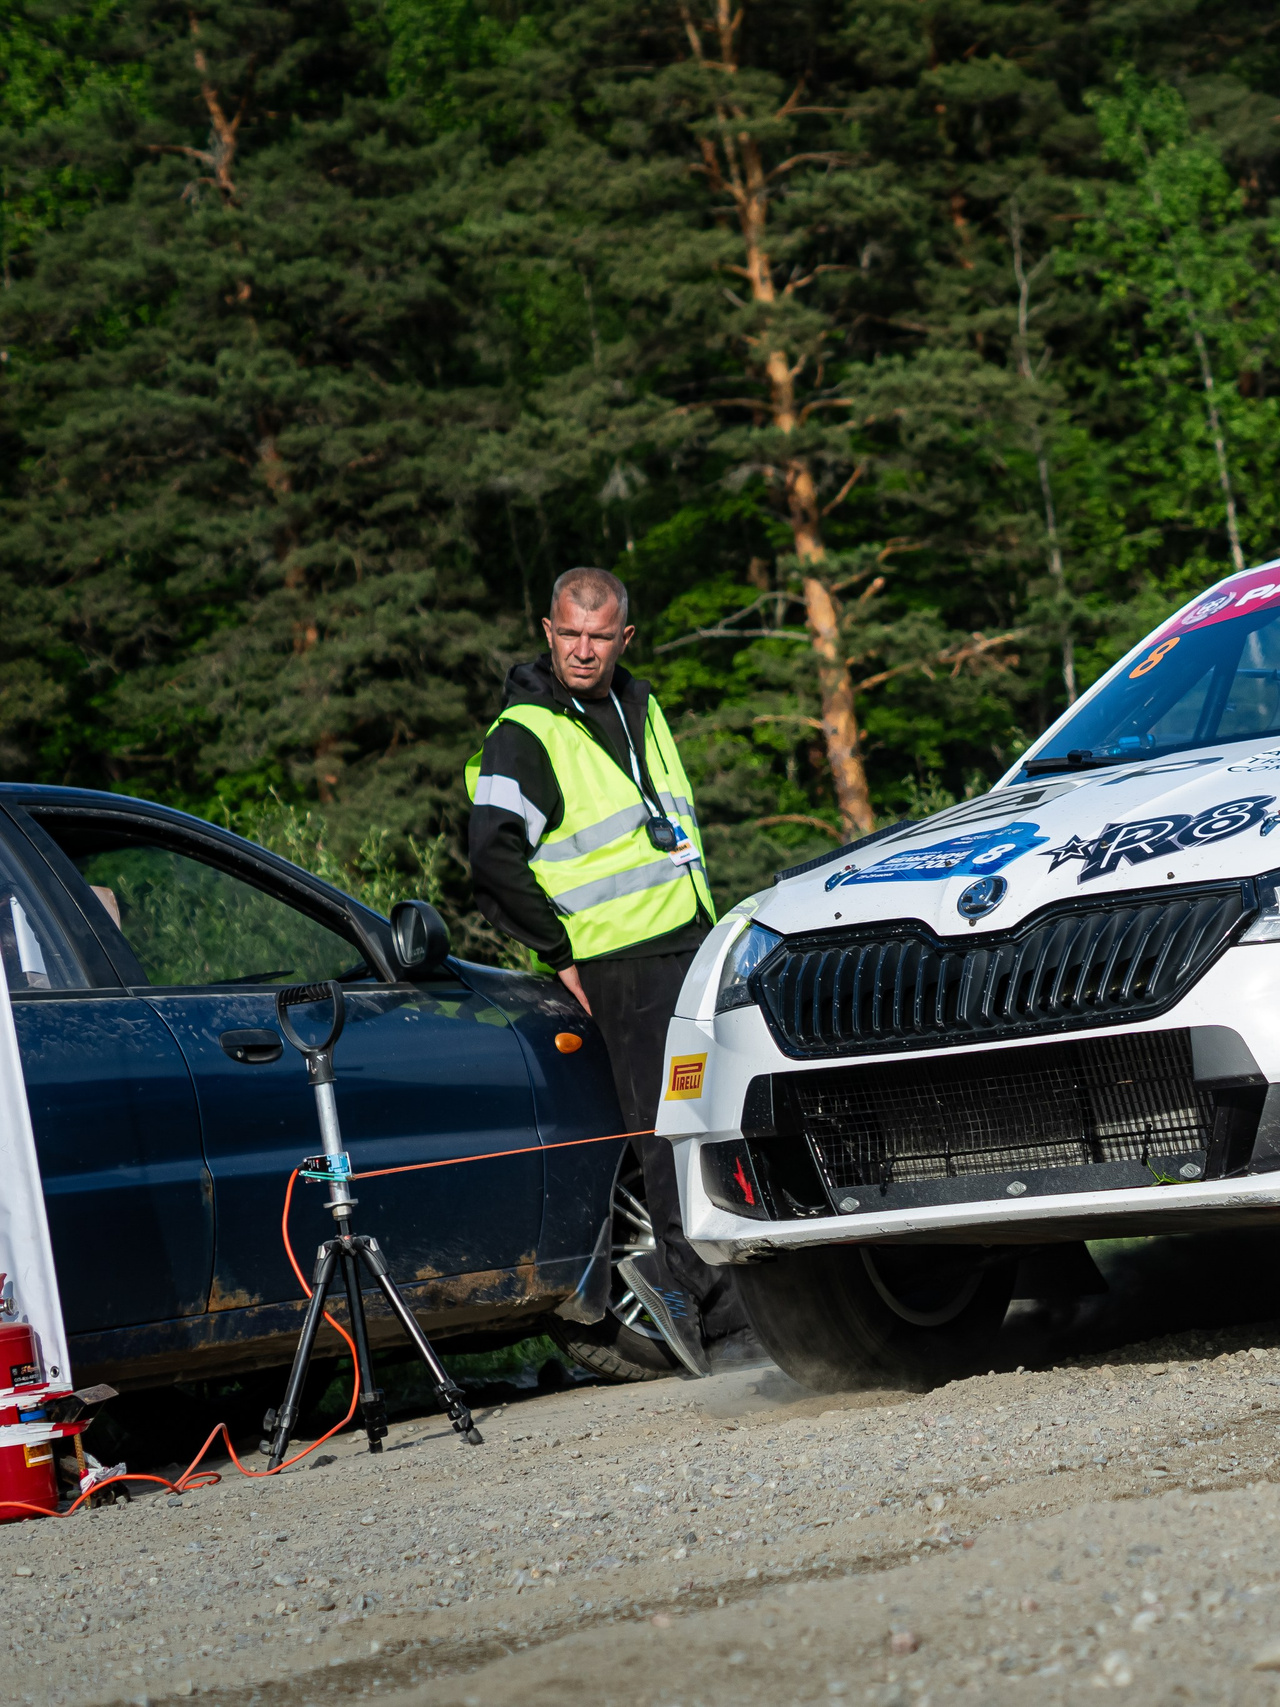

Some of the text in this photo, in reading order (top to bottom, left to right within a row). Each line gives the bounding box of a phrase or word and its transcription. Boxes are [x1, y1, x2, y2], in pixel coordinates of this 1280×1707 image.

[1129, 637, 1181, 680] 8
[971, 842, 1018, 865] 8
[671, 1062, 703, 1092] PIRELLI
